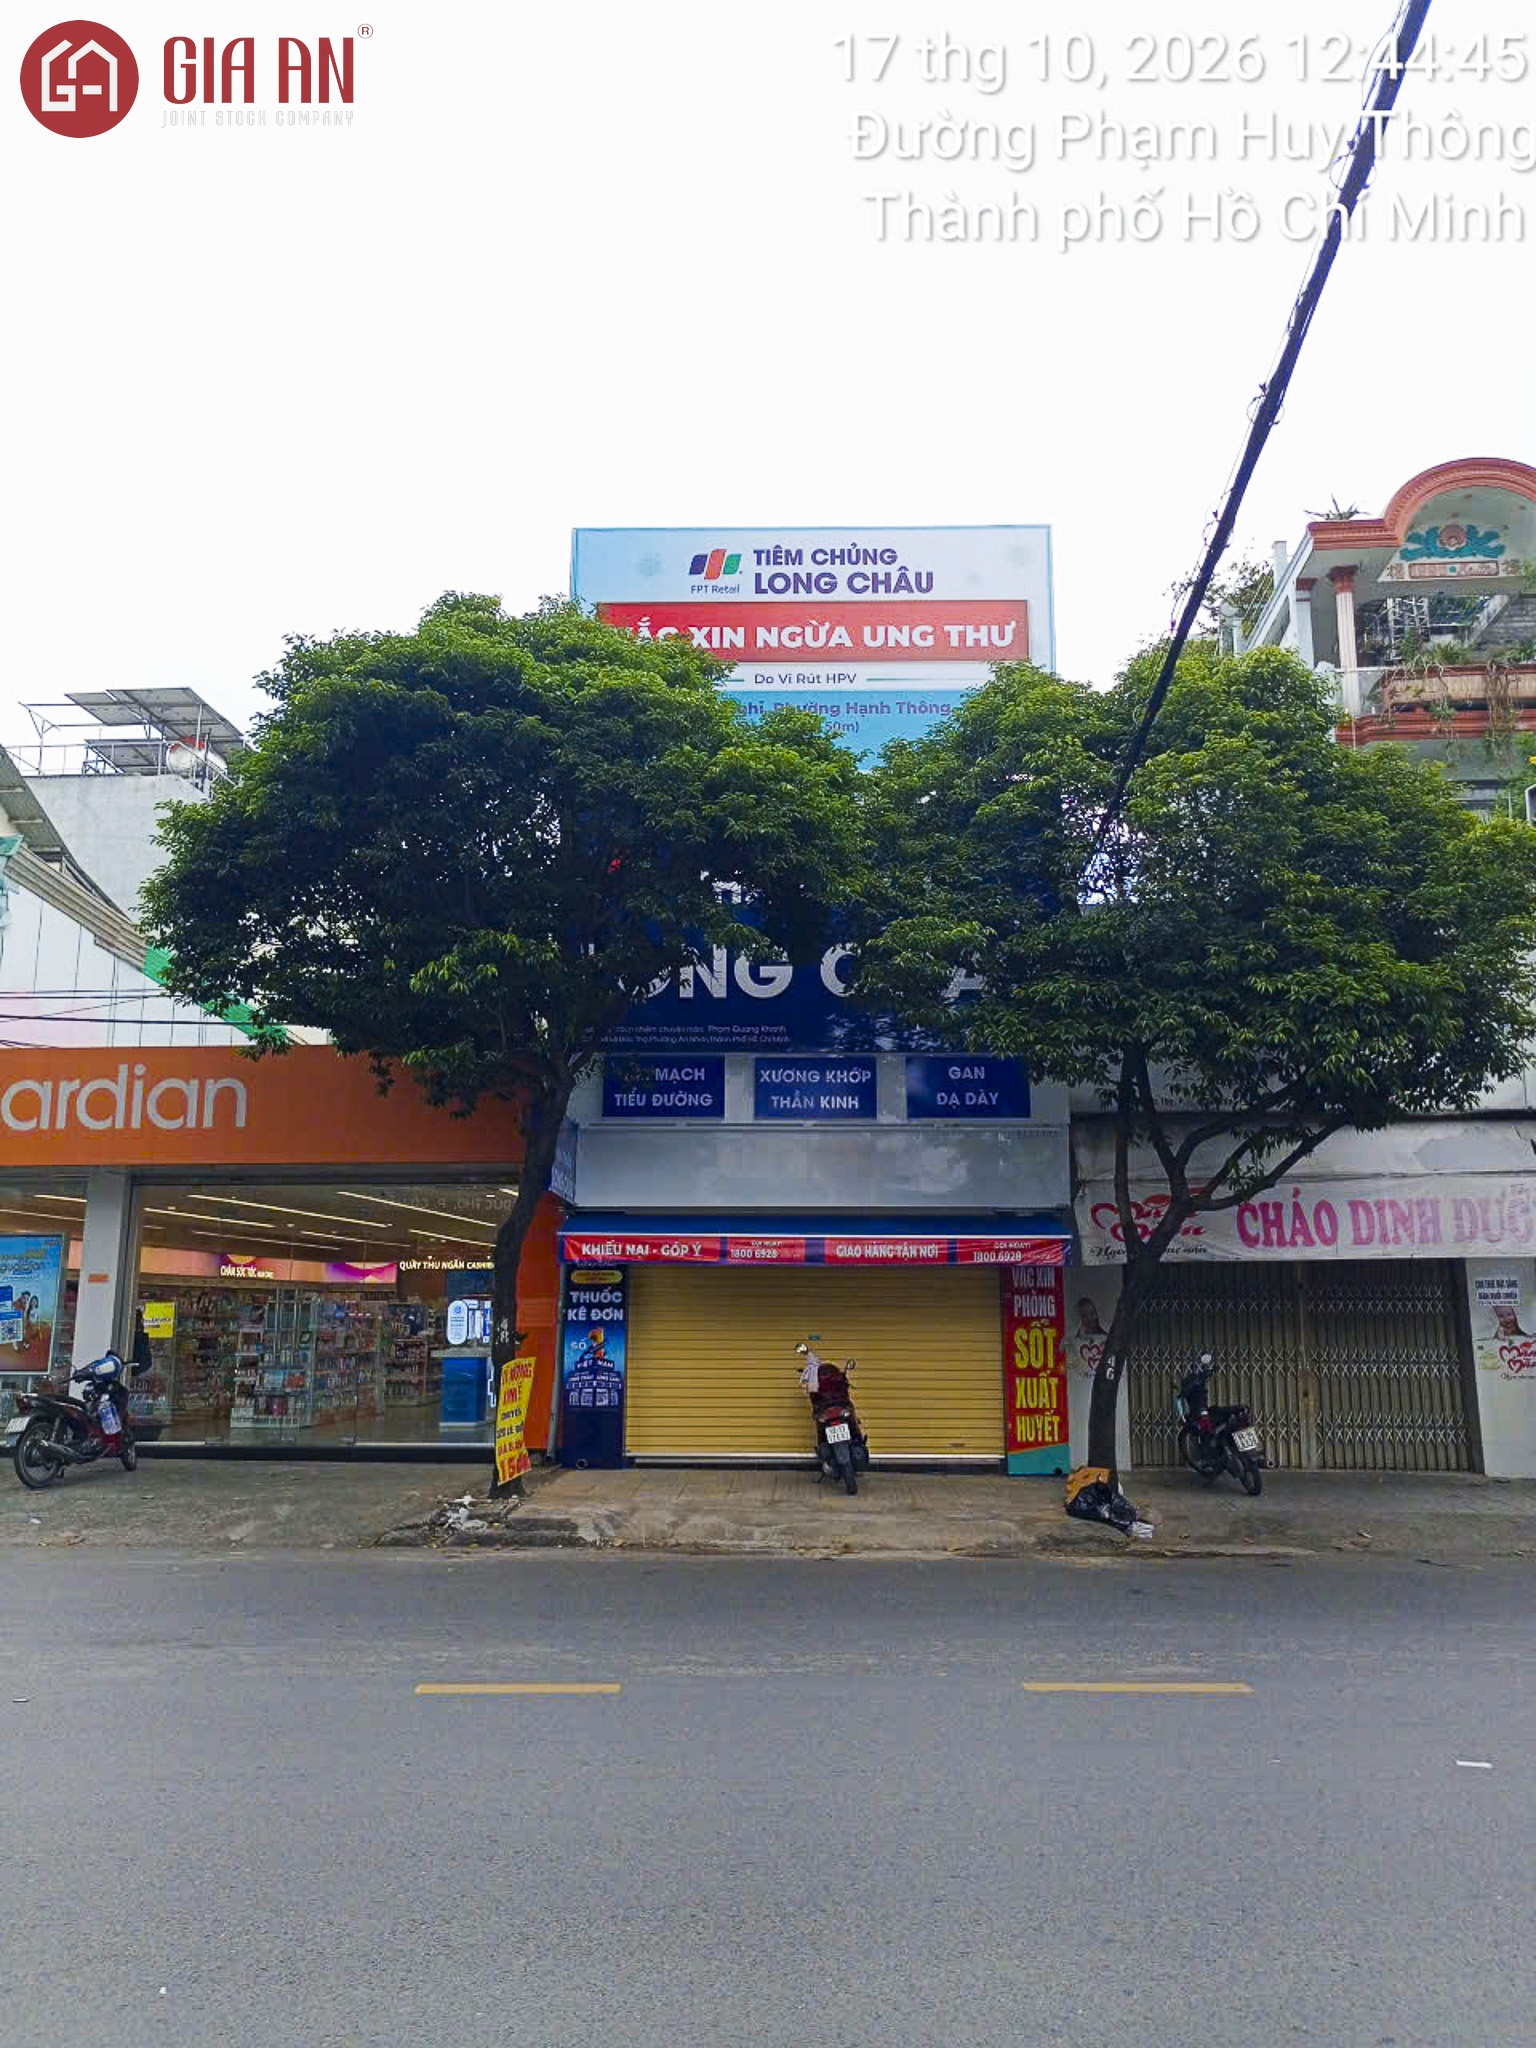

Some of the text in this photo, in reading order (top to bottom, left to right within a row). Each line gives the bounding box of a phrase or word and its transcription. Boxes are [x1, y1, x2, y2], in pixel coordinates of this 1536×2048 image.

[753, 541, 898, 566] TIÊM CHỦNG
[691, 584, 740, 594] FPT Retail
[754, 566, 934, 595] LONG CHÂU
[690, 625, 745, 649] XIN
[756, 620, 853, 648] NGỪA
[864, 624, 935, 648] UNG
[944, 621, 1017, 648] THƯ
[754, 673, 775, 685] Do
[797, 672, 822, 685] Rút
[826, 673, 857, 685] HPV
[845, 702, 891, 718] Hạnh
[655, 1067, 705, 1084] MẠCH
[760, 1068, 871, 1083] XƯƠNG KHỚP
[948, 1066, 985, 1080] GAN
[0, 1063, 248, 1132] ardian
[651, 1091, 713, 1107] ĐƯỜNG
[771, 1090, 859, 1109] THẦN KINH
[965, 1089, 999, 1105] DÀY
[1349, 1198, 1443, 1246] DINH
[582, 1240, 622, 1256] KHIẾU
[661, 1243, 689, 1257] GÓP
[693, 1242, 702, 1257] Ý
[836, 1244, 861, 1258] GIAO
[864, 1242, 894, 1258] HÀNG
[423, 1261, 440, 1270] THU
[569, 1286, 623, 1303] THUỐC
[1014, 1290, 1057, 1318] PHÒNG
[568, 1305, 624, 1321] KÊ ĐƠN
[1014, 1318, 1057, 1369] SỐT
[1015, 1369, 1059, 1409] XUẤT
[1017, 1409, 1060, 1443] HUYẾT
